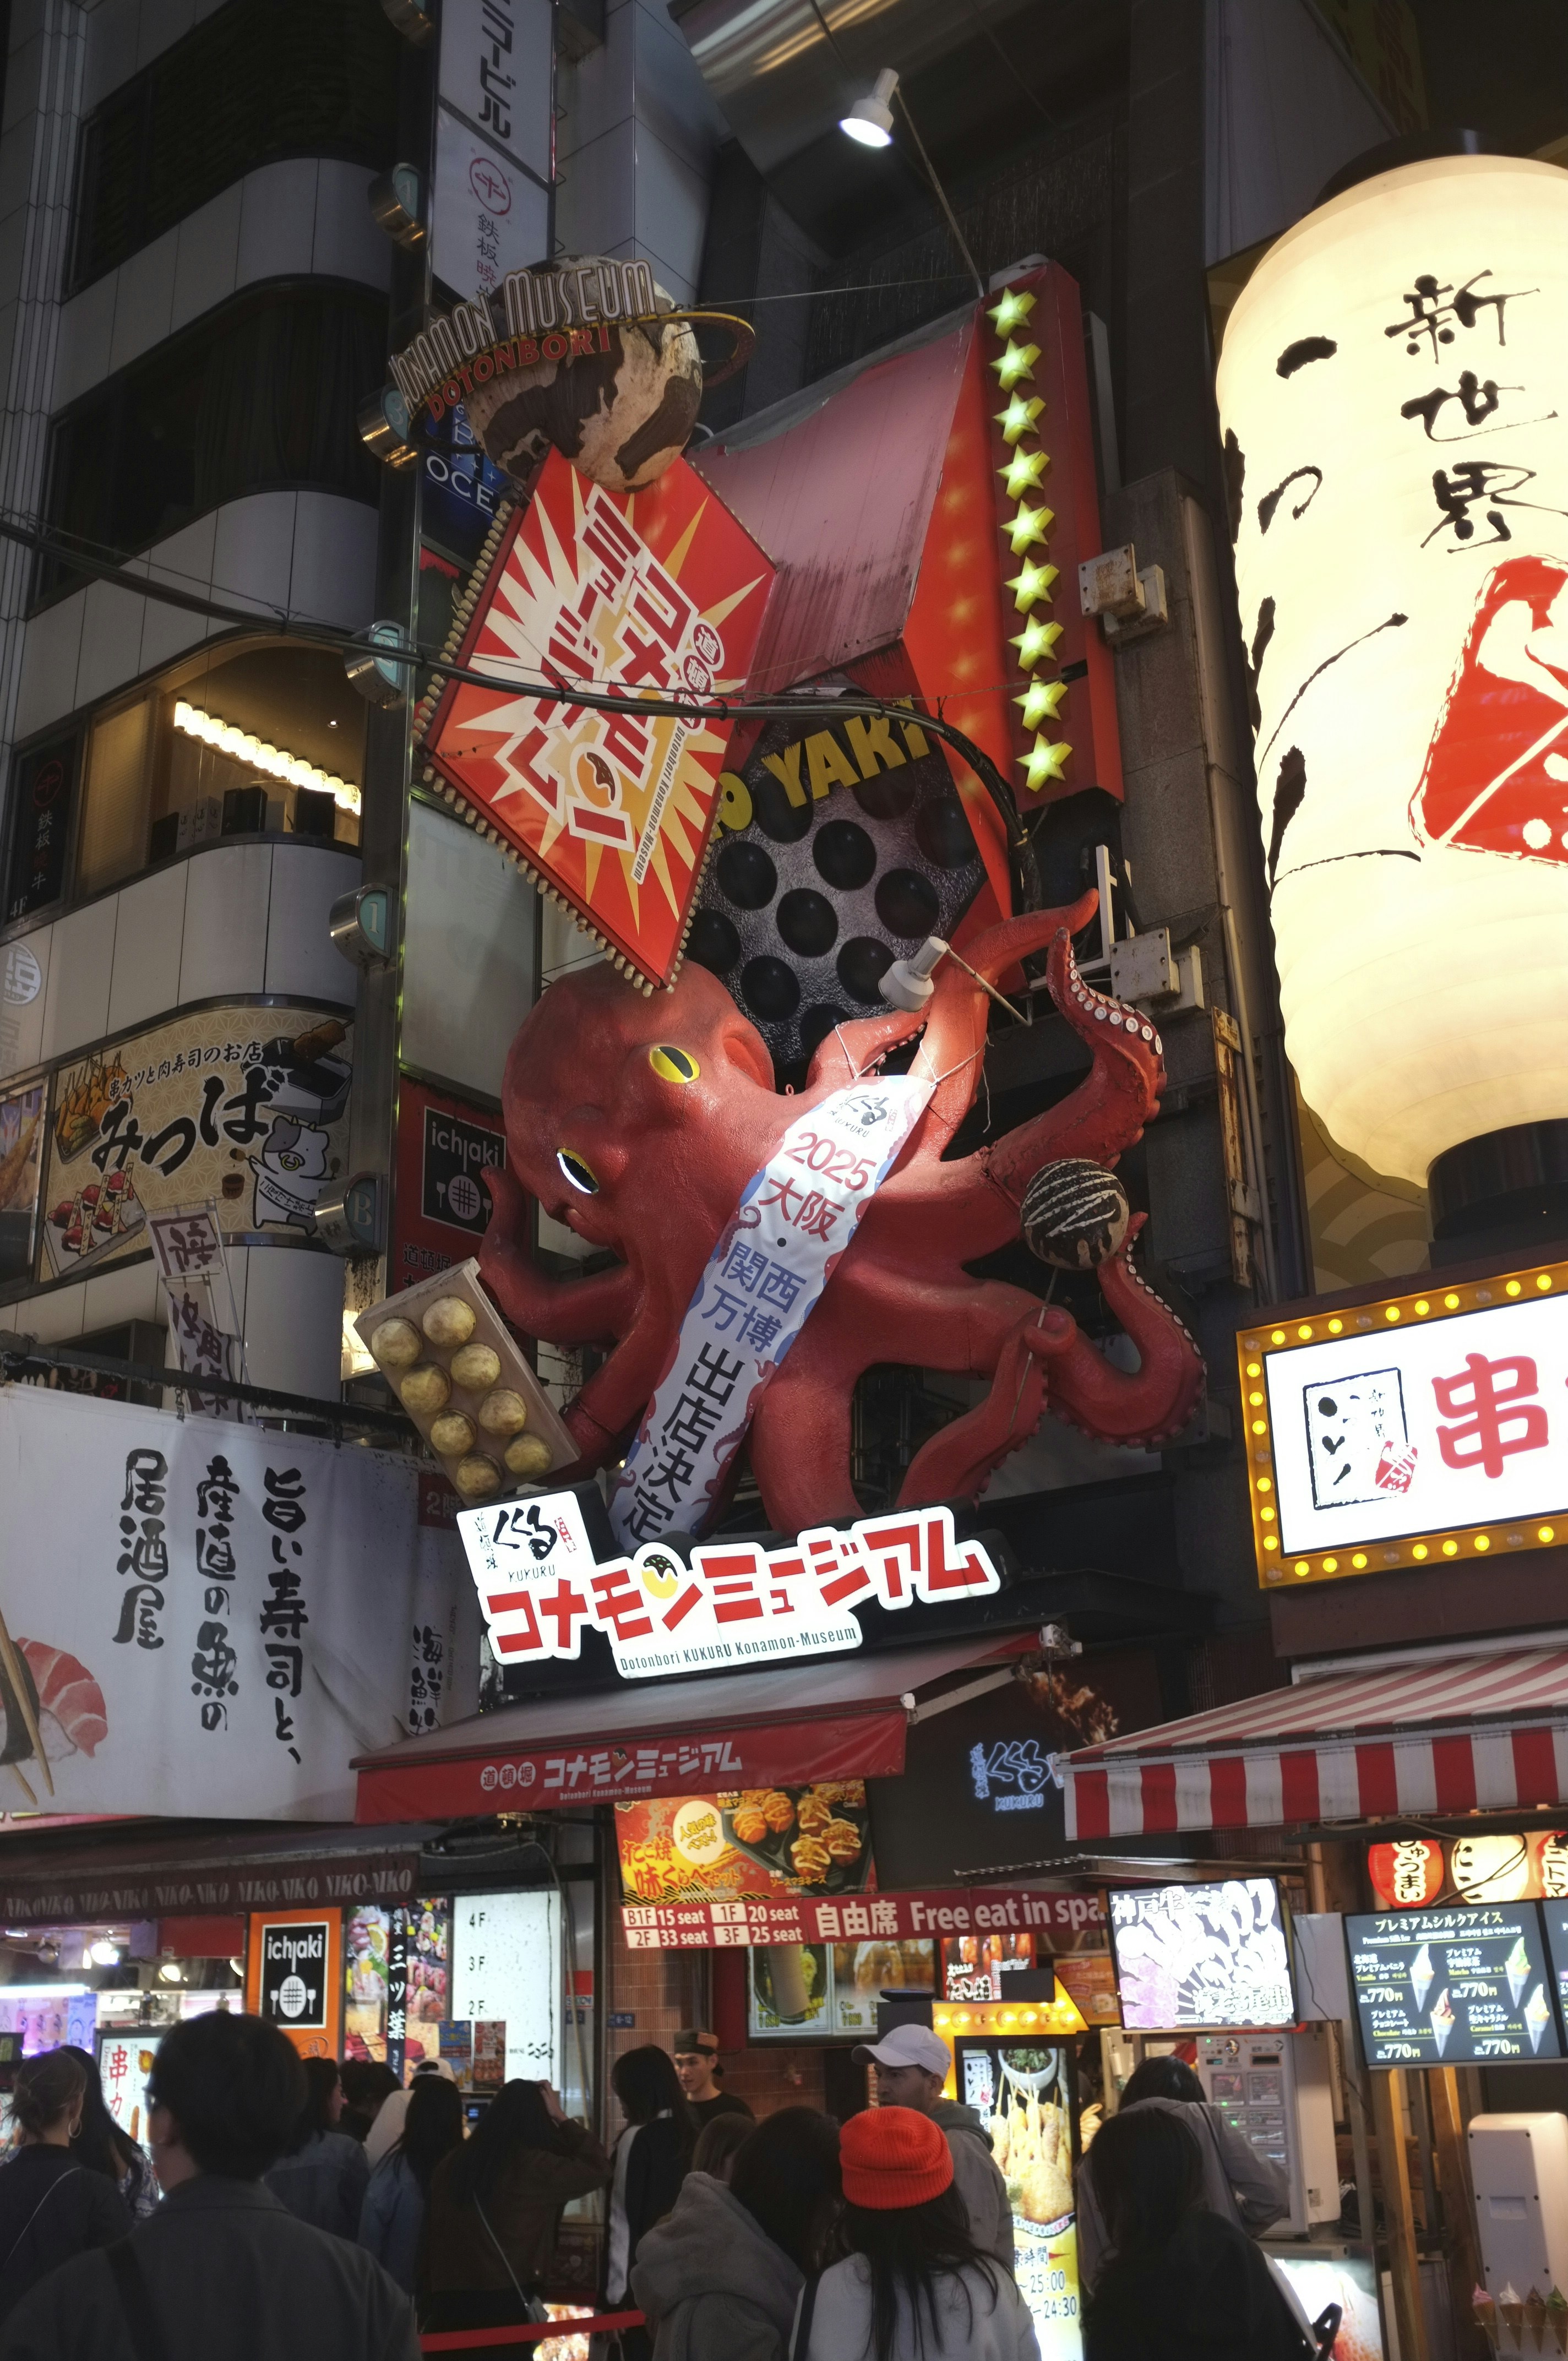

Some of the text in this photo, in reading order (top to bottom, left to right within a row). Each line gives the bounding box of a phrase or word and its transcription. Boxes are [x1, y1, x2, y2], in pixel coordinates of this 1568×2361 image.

[478, 0, 516, 139] コービル
[503, 259, 657, 338] MUSEUM
[427, 326, 611, 423] DOTONBORI
[761, 695, 930, 808] YAKI
[633, 725, 685, 882] Dotonbori Konamon-Museum
[9, 895, 27, 918] 4F
[369, 901, 379, 934] 1
[109, 1040, 263, 1100] 串カツと肉寿司のお店
[91, 1066, 287, 1177] みつば
[784, 1131, 878, 1191] 2025
[353, 1189, 373, 1227] B
[757, 1176, 845, 1244] 大阪
[721, 1240, 807, 1315] 関西
[701, 1283, 784, 1353] 万博
[1431, 1352, 1549, 1479] 串
[622, 1341, 746, 1543] 出店決定
[112, 1448, 169, 1650] 居酒屋
[493, 1504, 558, 1560] くくる
[191, 1455, 240, 1731] 産直の魚の
[487, 1519, 990, 1654] コナモンミュージアム
[508, 1564, 556, 1582] KUKURU
[259, 1466, 309, 1764] 旨い寿司と、
[620, 1626, 857, 1672] Dotonbori KUKURU Konamon-Museum
[543, 1741, 743, 1789] コナモンミュージアム
[994, 1793, 1044, 1812] KUKURU
[623, 1836, 673, 1867] たこ焼
[633, 1863, 741, 1898] 味くらべセット
[469, 1912, 486, 1927] 4F
[628, 1905, 799, 1927] B1F 15 seat 1F 20 seat
[635, 1925, 803, 1947] 2F 33 seat 3F 25 seat
[816, 1894, 1103, 1938] 自由席 Free eat in spa
[1375, 1910, 1504, 1934] プレミアムシルクアイス
[469, 1956, 486, 1972] 3F
[1355, 1961, 1406, 1974] プレミアムバニラ
[1446, 1947, 1482, 1958] プレミアム
[469, 2000, 486, 2015] 2F
[1367, 1987, 1404, 2003] 770円
[1460, 1981, 1498, 1998] 770円
[1467, 2004, 1505, 2015] プレミアム
[1371, 2009, 1406, 2020] プレミアム
[1372, 2018, 1409, 2029] チョコレート
[1384, 2042, 1422, 2059] 770円
[1482, 2038, 1521, 2056] 770円
[101, 2046, 111, 2100] Deep-frie
